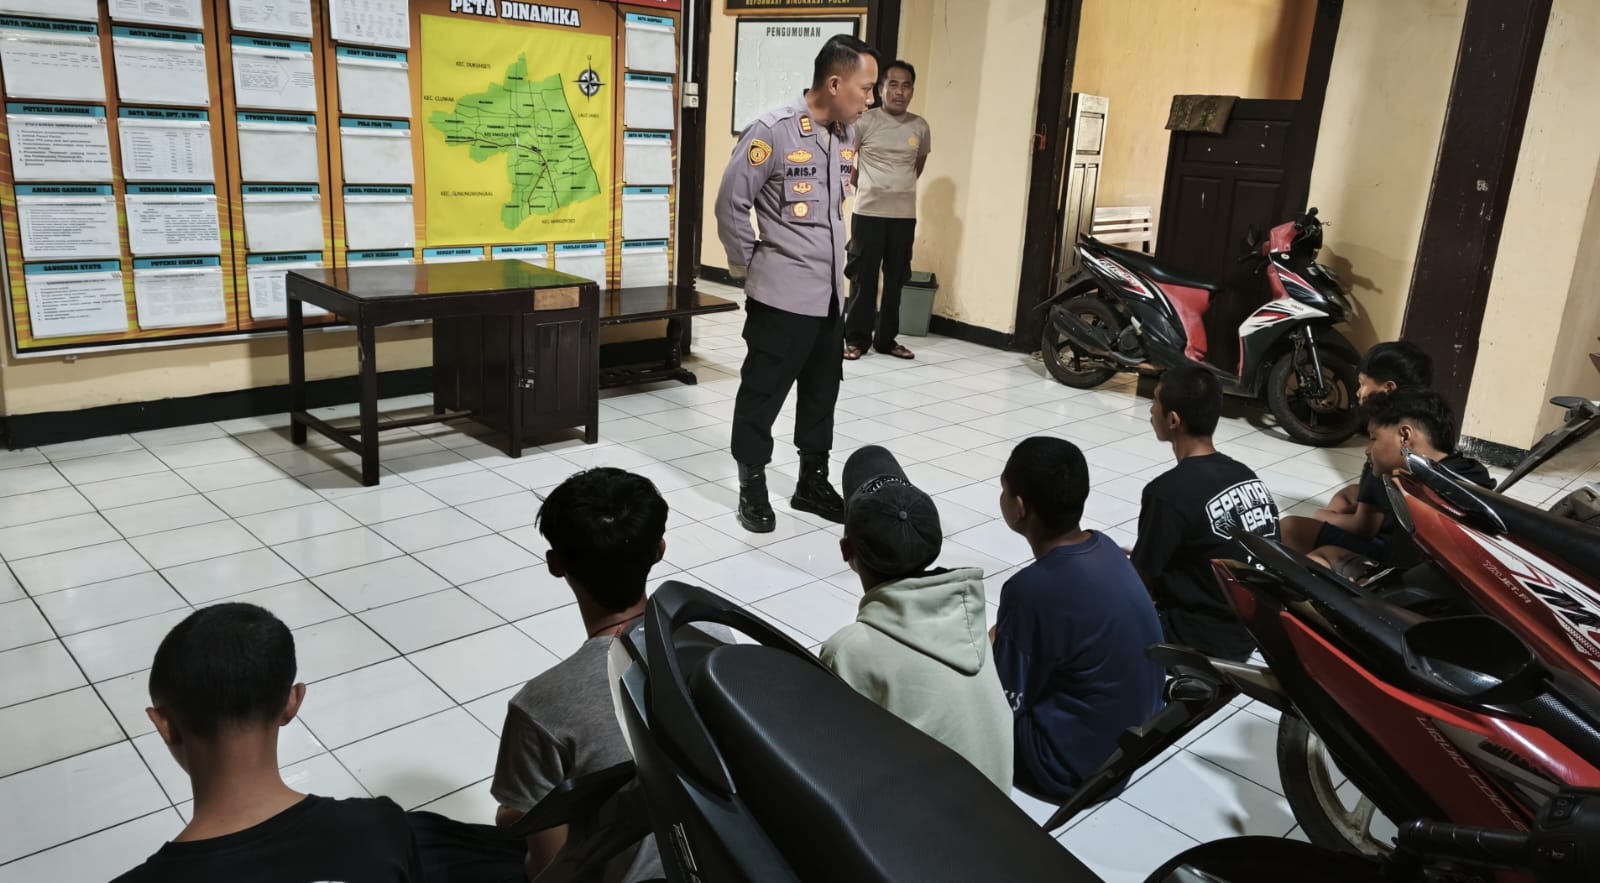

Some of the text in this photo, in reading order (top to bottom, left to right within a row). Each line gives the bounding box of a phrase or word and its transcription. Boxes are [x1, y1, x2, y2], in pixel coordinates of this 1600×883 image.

[450, 0, 580, 27] PETA DINAMIKA
[766, 26, 821, 37] PENGUMUMAN
[786, 167, 817, 177] ARIS.P
[1240, 504, 1275, 532] 1994
[1415, 716, 1470, 769] LIQUID
